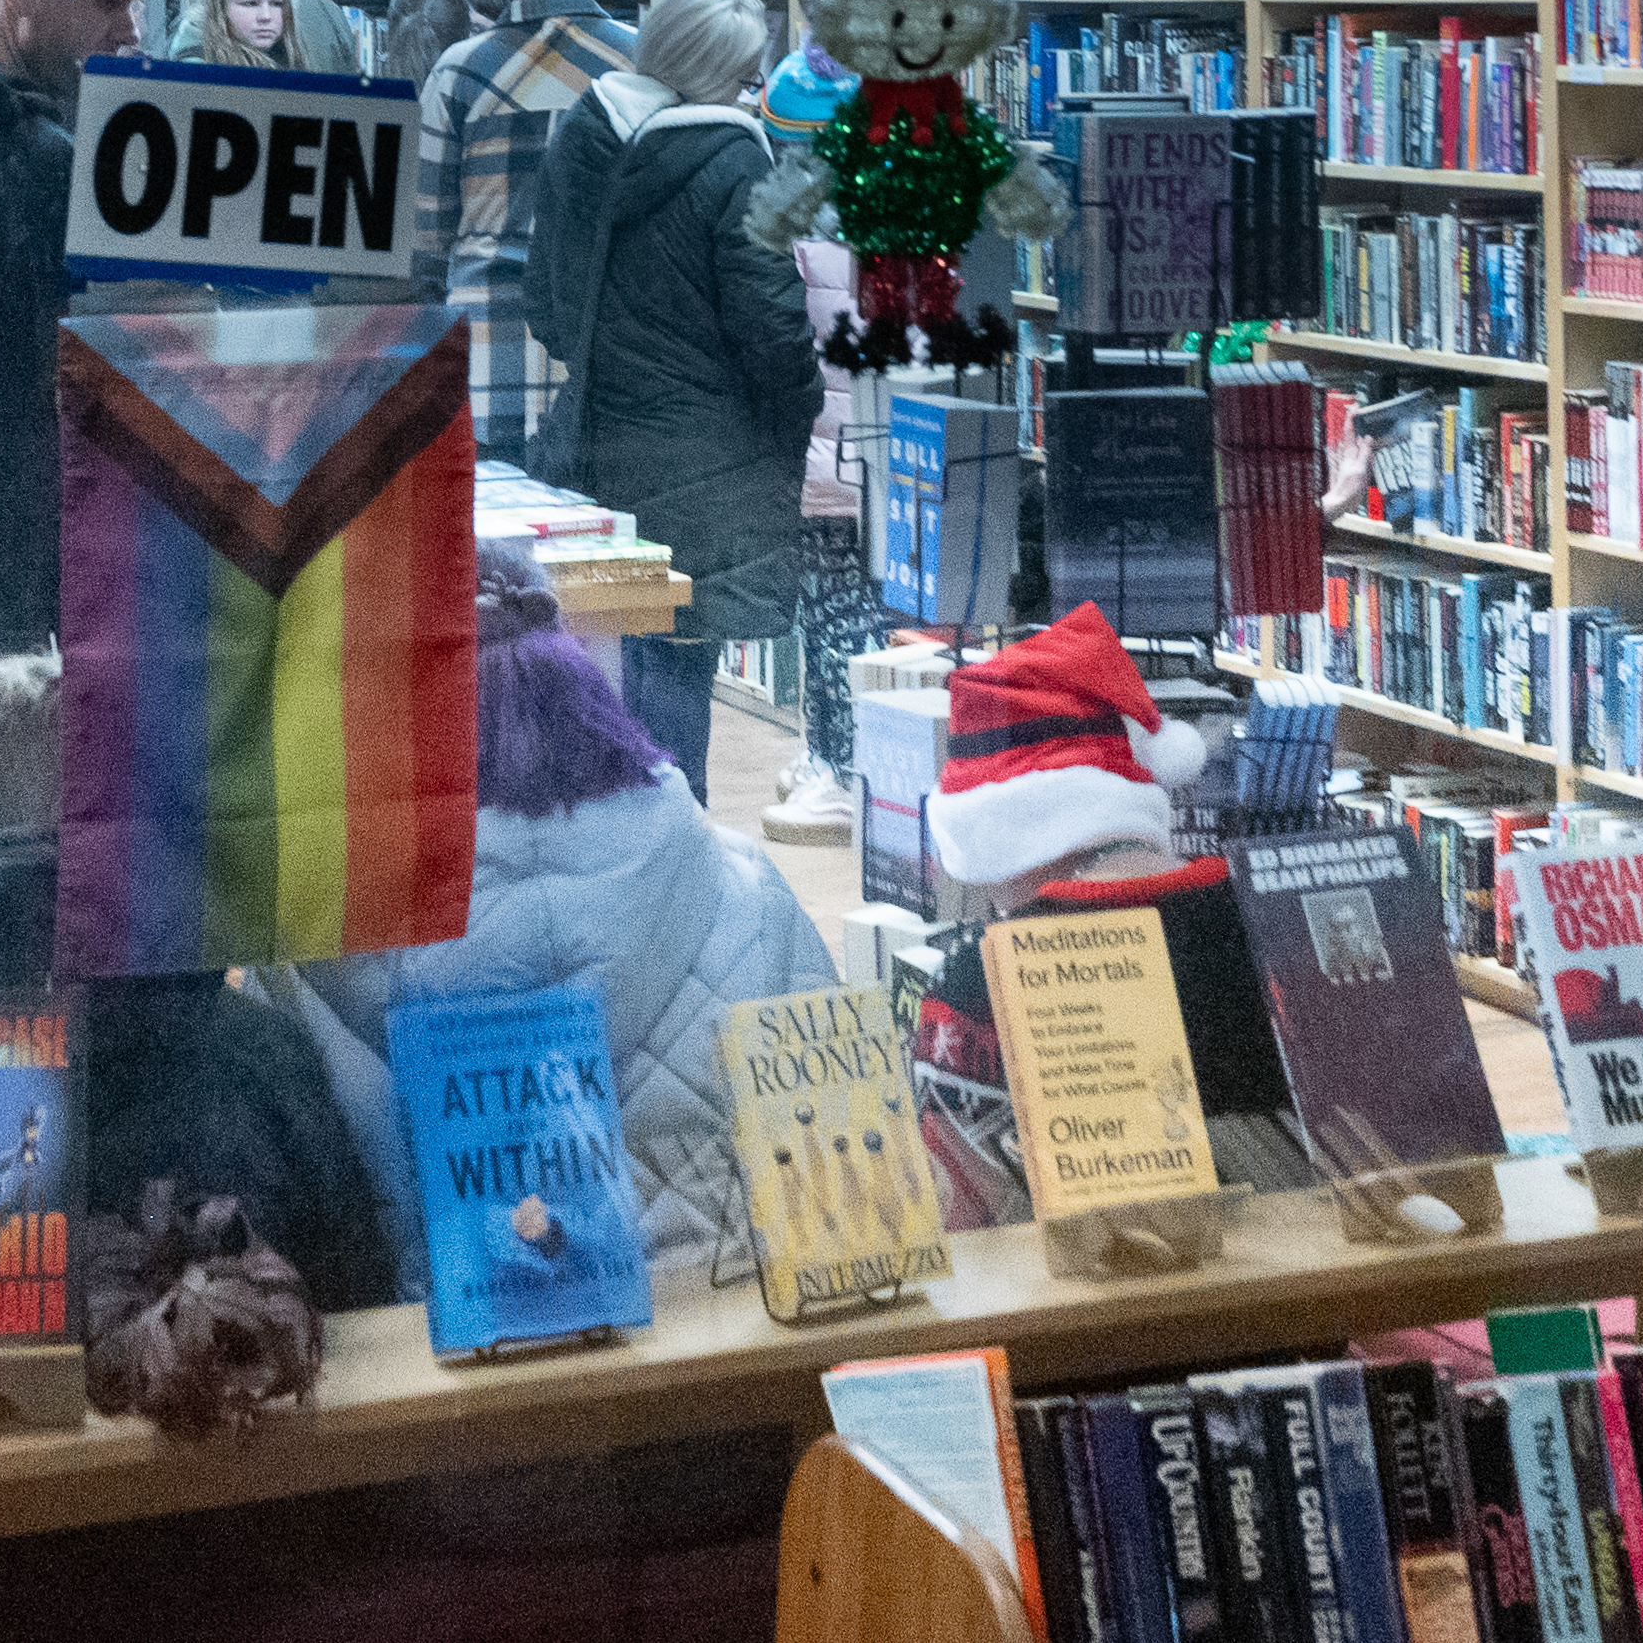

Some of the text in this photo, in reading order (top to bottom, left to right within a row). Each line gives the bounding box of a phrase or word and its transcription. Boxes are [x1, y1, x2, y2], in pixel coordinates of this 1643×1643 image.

[1106, 132, 1228, 169] IT ENDS
[93, 101, 403, 251] OPEN
[1106, 174, 1188, 212] WITH
[1107, 215, 1147, 254] US
[890, 436, 940, 472] BULL
[1247, 835, 1399, 870] ED BRUBAKER
[1250, 857, 1410, 894] SEAN PHILLIPS
[1011, 924, 1147, 957] Meditations
[1018, 957, 1145, 989] for Mortals
[757, 992, 867, 1045] SALLY
[443, 1055, 607, 1118] ATTACK
[747, 1033, 896, 1098] ROONEY
[1589, 1050, 1641, 1087] We
[1049, 1114, 1127, 1146] Oliver
[446, 1134, 618, 1199] WITHIN
[1055, 1148, 1195, 1183] Burkeman
[795, 1242, 948, 1298] INTERMEZZO
[1283, 1398, 1317, 1480] FULL
[1385, 1392, 1432, 1524] FOLLETT
[1421, 1421, 1453, 1488] KEN
[1225, 1465, 1264, 1583] Rankin
[1296, 1486, 1336, 1596] COUNT
